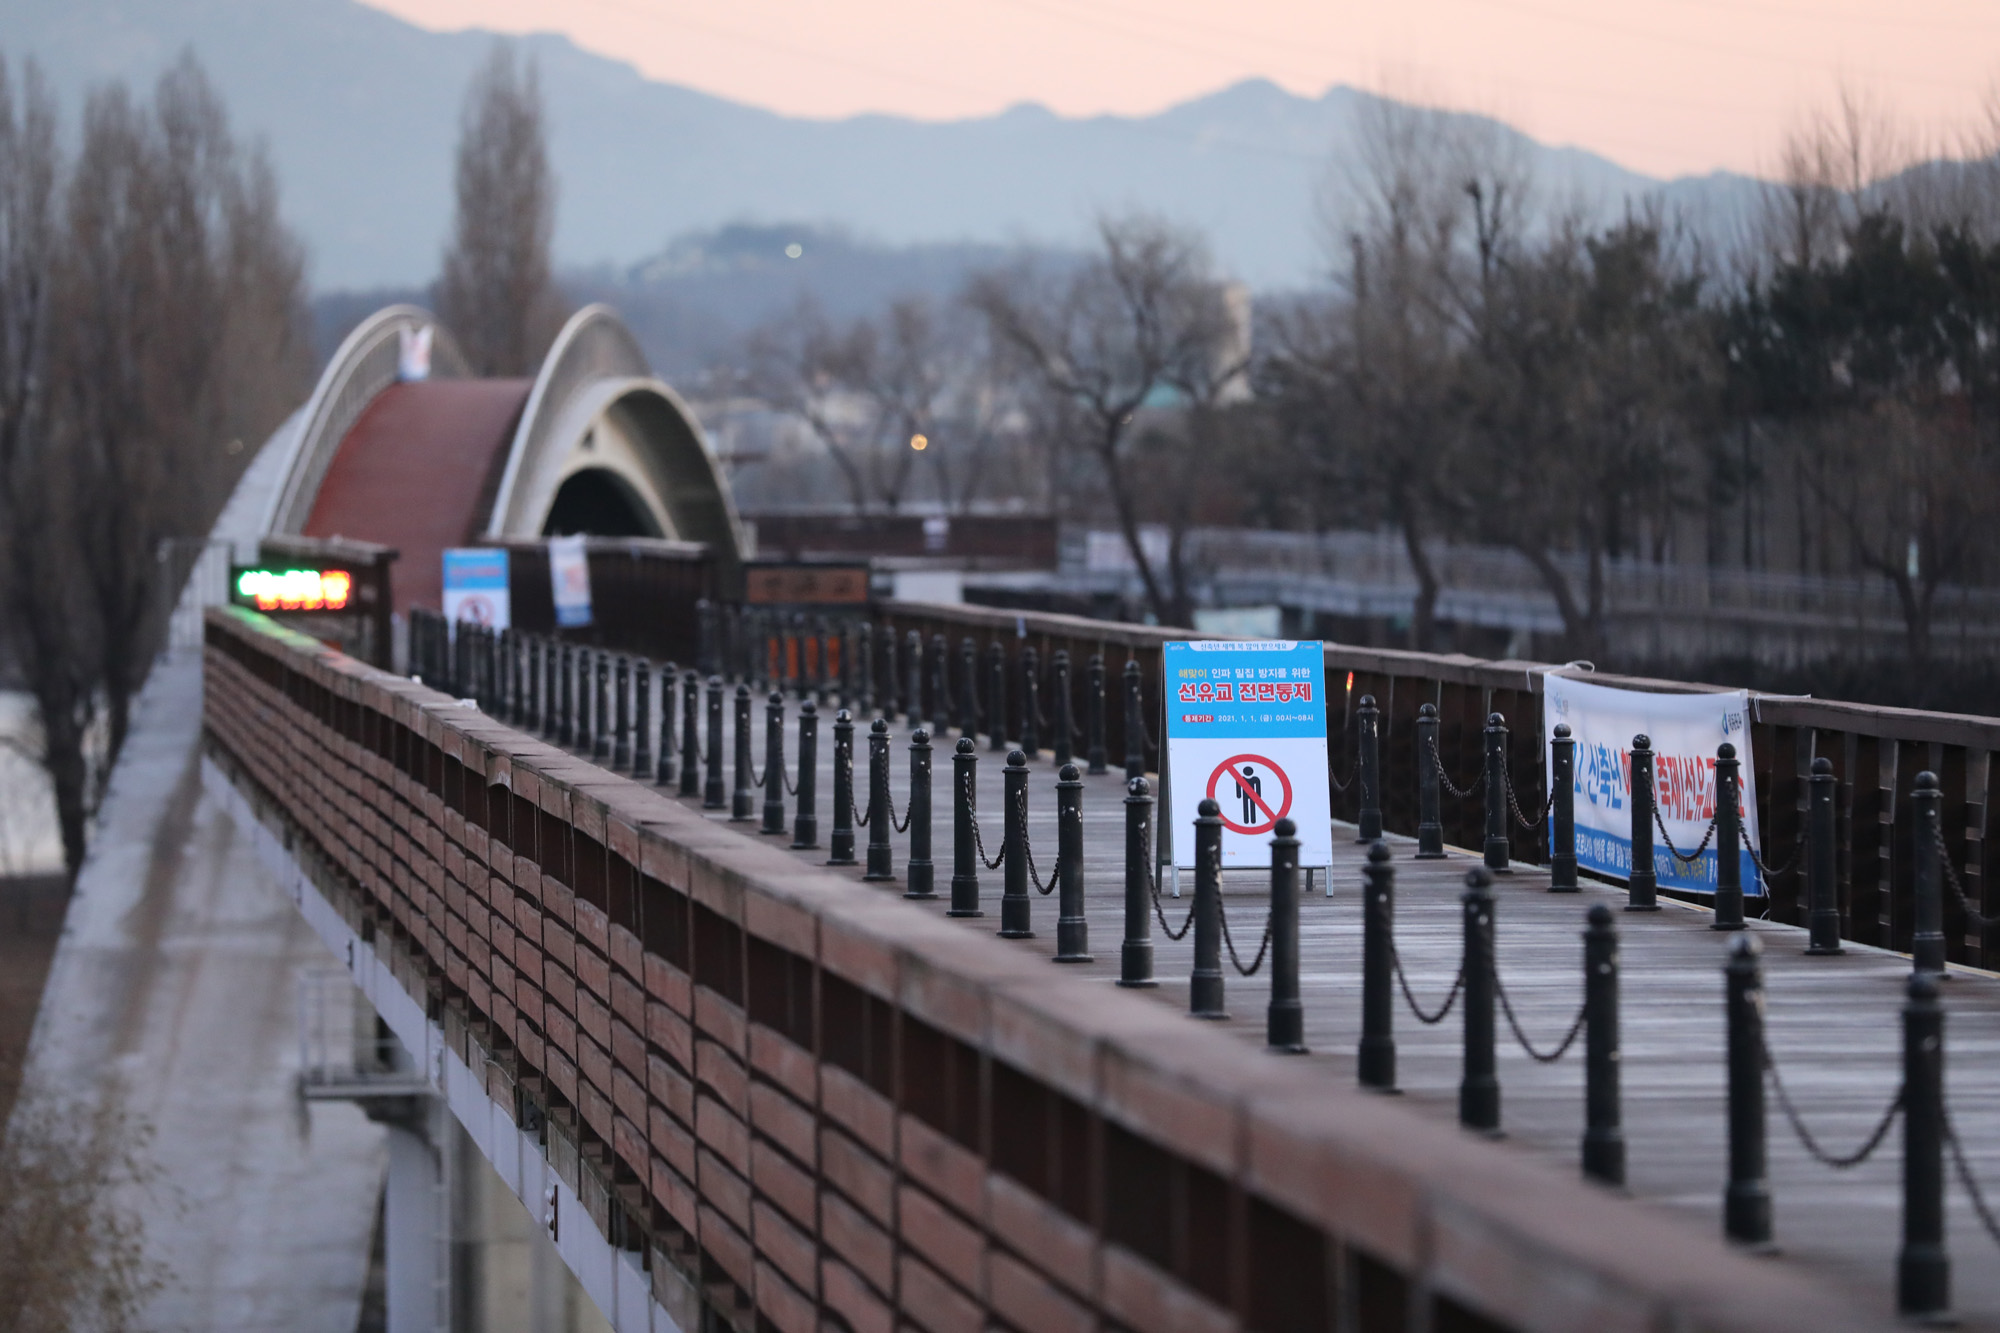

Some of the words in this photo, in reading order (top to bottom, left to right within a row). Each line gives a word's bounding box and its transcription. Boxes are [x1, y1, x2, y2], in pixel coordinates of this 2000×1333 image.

[1178, 668, 1207, 679] 해맞이
[1211, 668, 1231, 679] 인파
[1235, 668, 1254, 679] 밀집
[1258, 668, 1287, 678] 방지를
[1291, 668, 1311, 678] 위한
[1178, 682, 1234, 702] 선유교
[1239, 682, 1312, 702] 전면통제
[1588, 741, 1622, 809] 신축년
